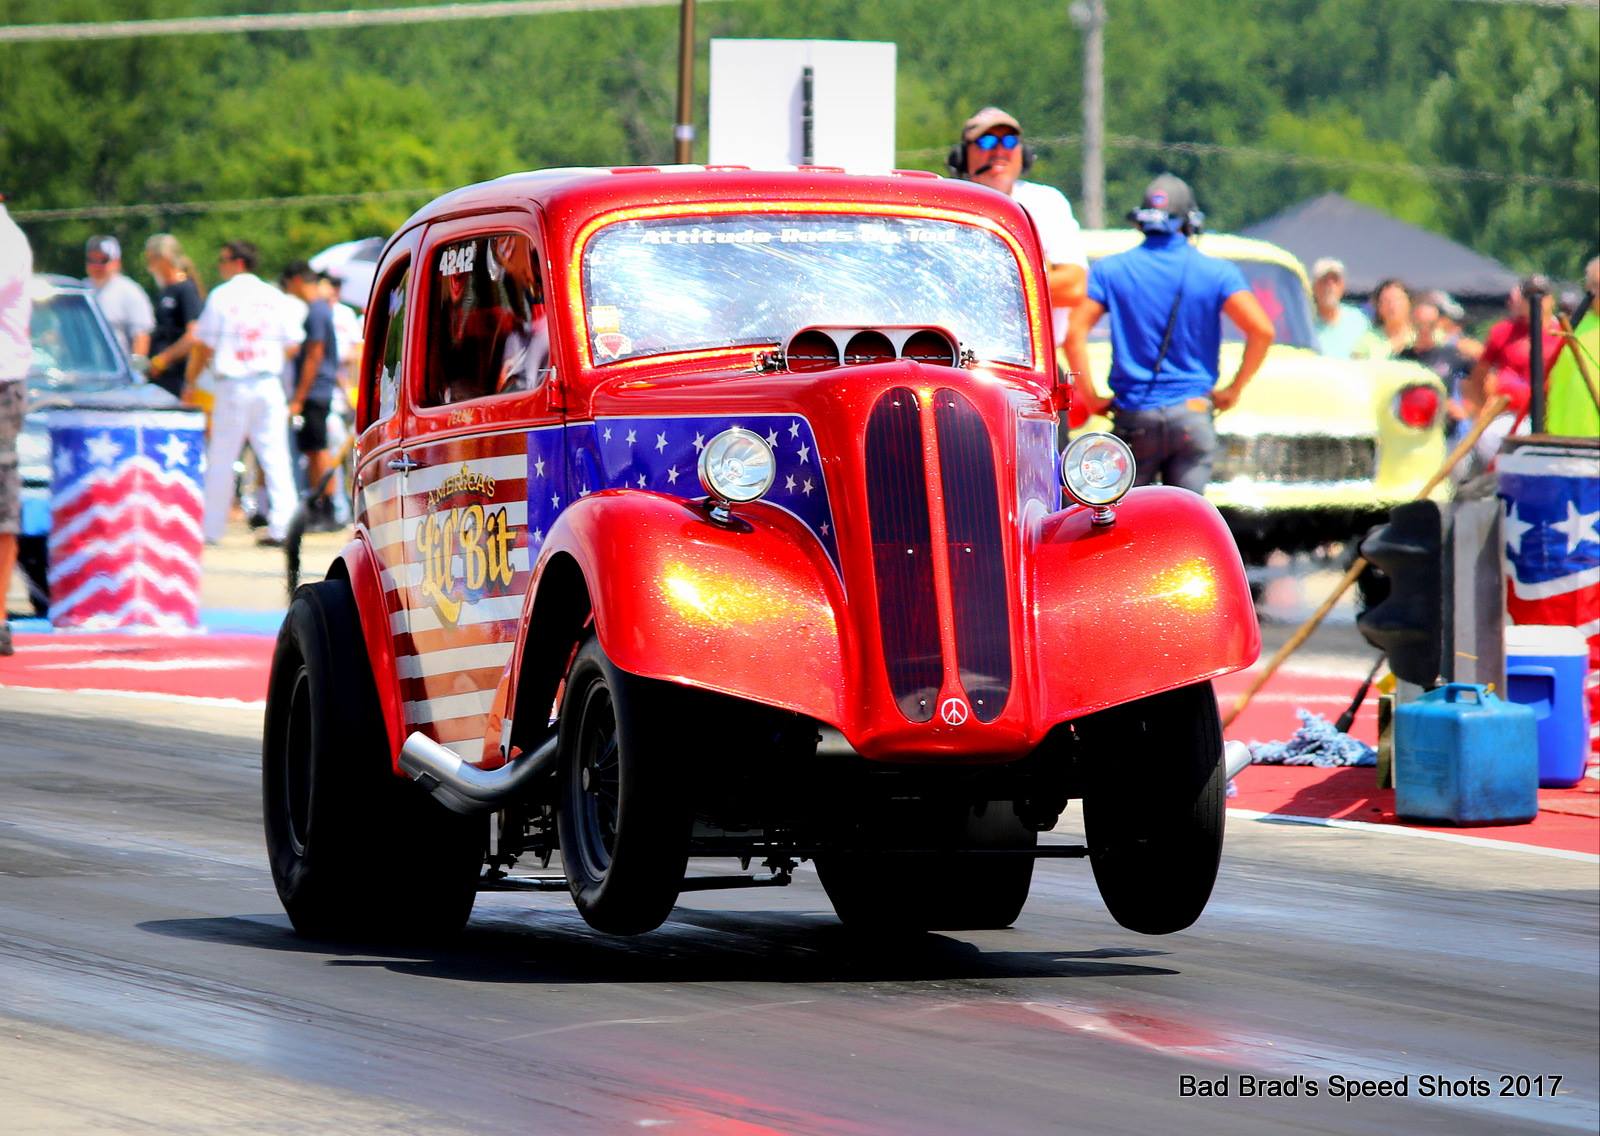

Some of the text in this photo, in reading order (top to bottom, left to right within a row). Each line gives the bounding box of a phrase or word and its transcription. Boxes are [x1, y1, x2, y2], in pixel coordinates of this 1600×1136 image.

[640, 228, 771, 244] Attitude
[781, 228, 854, 243] Rods
[439, 245, 474, 276] 4242
[427, 472, 496, 507] AMERICA'S
[459, 504, 517, 591] Bit
